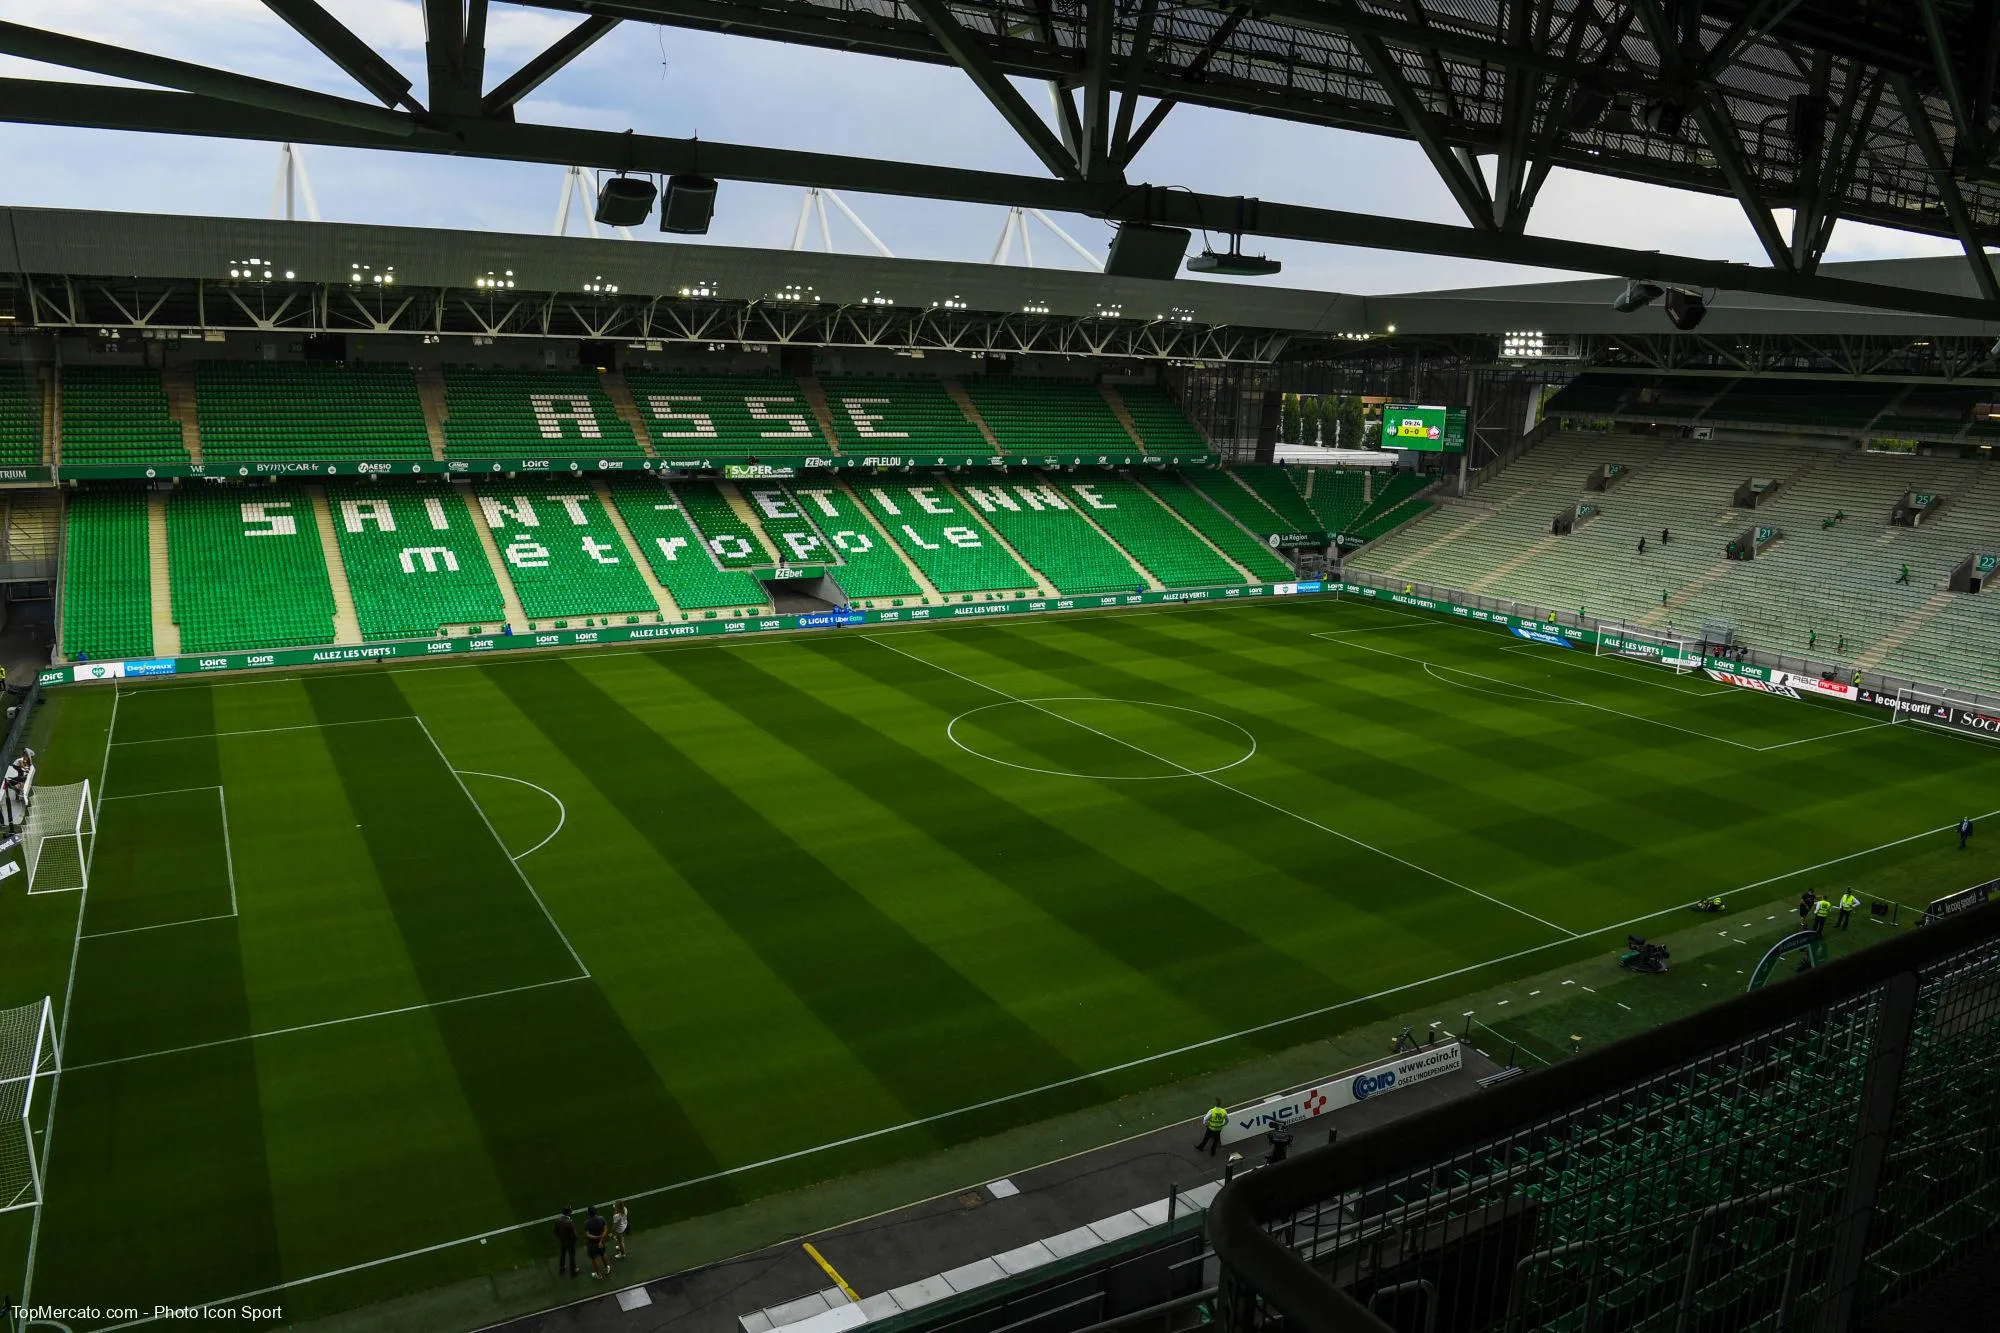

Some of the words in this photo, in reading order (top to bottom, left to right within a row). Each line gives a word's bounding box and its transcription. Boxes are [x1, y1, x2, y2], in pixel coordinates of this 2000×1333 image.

[530, 395, 909, 438] ASSE
[863, 457, 901, 466] AFFLELOU
[1982, 557, 1994, 568] 22
[775, 568, 803, 579] ZEbet
[955, 606, 973, 615] ALLEZ
[974, 606, 985, 614] LES
[630, 628, 654, 638] ALLEZ
[656, 627, 668, 636] LES
[670, 626, 694, 635] VERTS
[313, 651, 341, 661] ALLEZ
[344, 650, 360, 659] LES
[361, 647, 390, 657] VERTS
[1875, 693, 1884, 704] le
[1399, 1047, 1459, 1075] www.coiro.fr
[1398, 1075, 1413, 1086] OSEZ
[1413, 1061, 1460, 1081] L'INDEPENDANCE
[1240, 1105, 1299, 1129] VINCI
